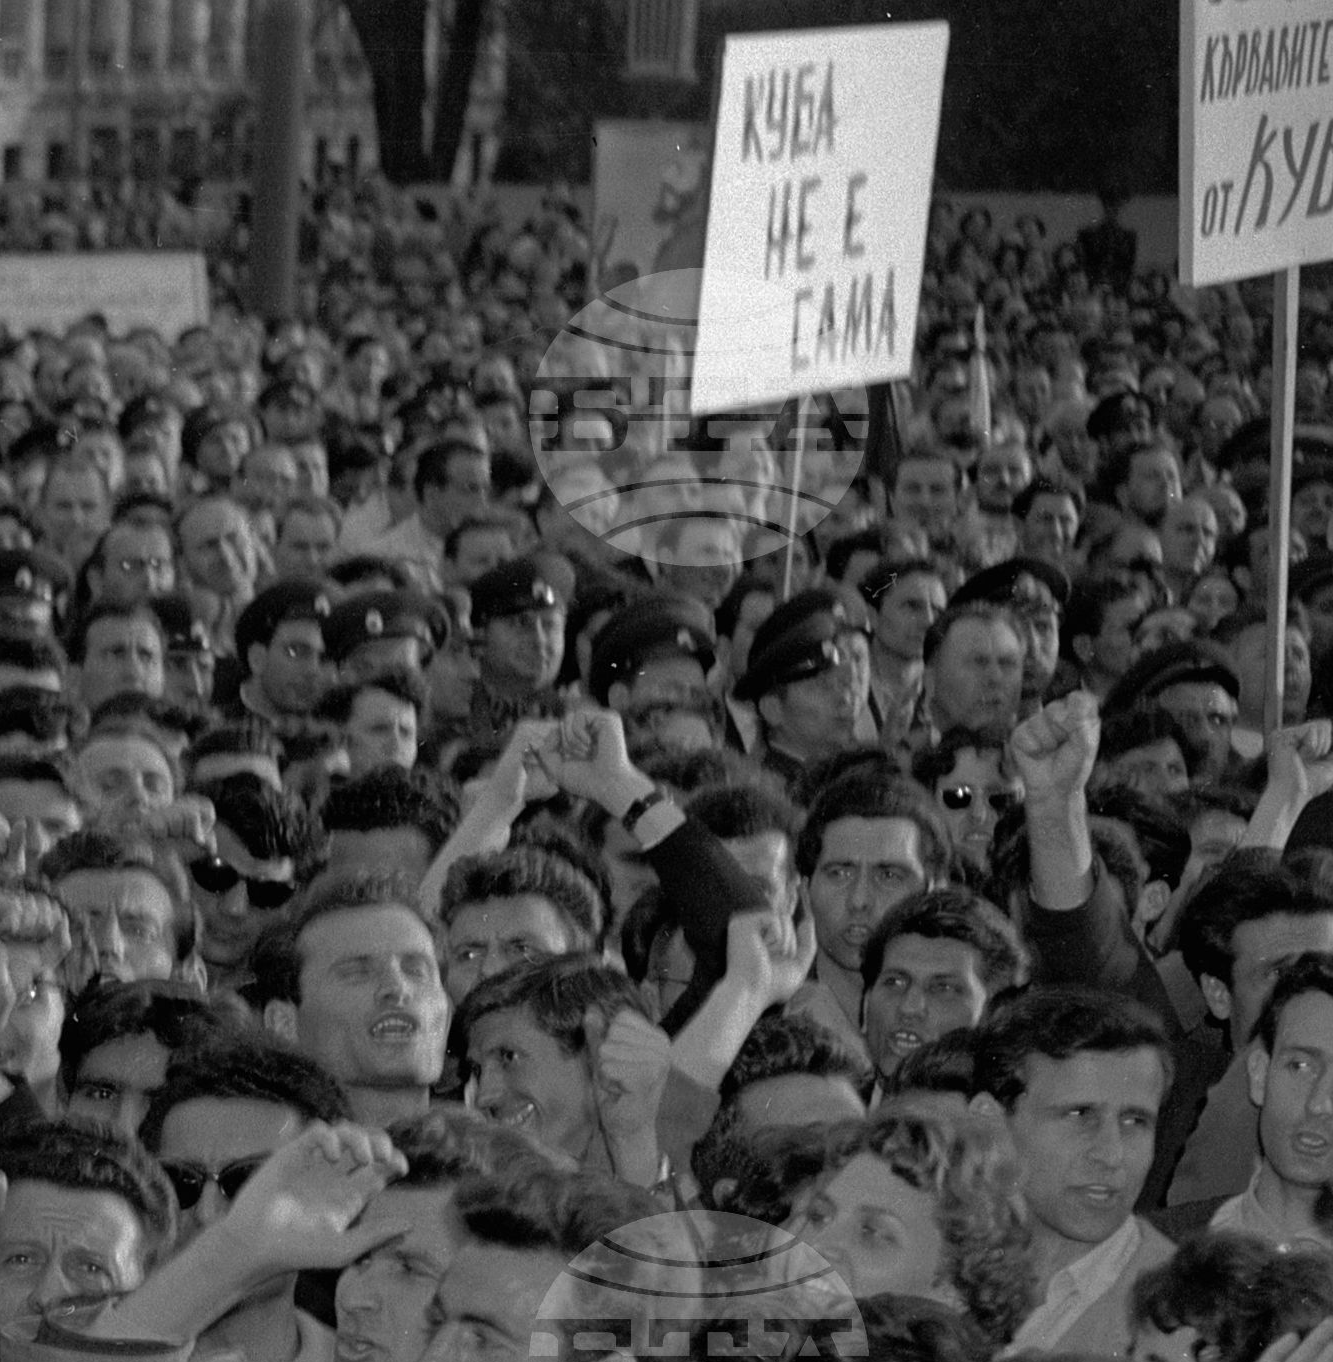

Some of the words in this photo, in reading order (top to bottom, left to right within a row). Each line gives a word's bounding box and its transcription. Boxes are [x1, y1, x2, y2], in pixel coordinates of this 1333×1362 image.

[741, 58, 838, 164] КУБА
[1199, 19, 1333, 104] КЪРВАВИТЕ
[764, 174, 822, 281] НЕ
[842, 170, 869, 257] Е
[1200, 181, 1234, 239] ОТ
[790, 266, 899, 373] САМА
